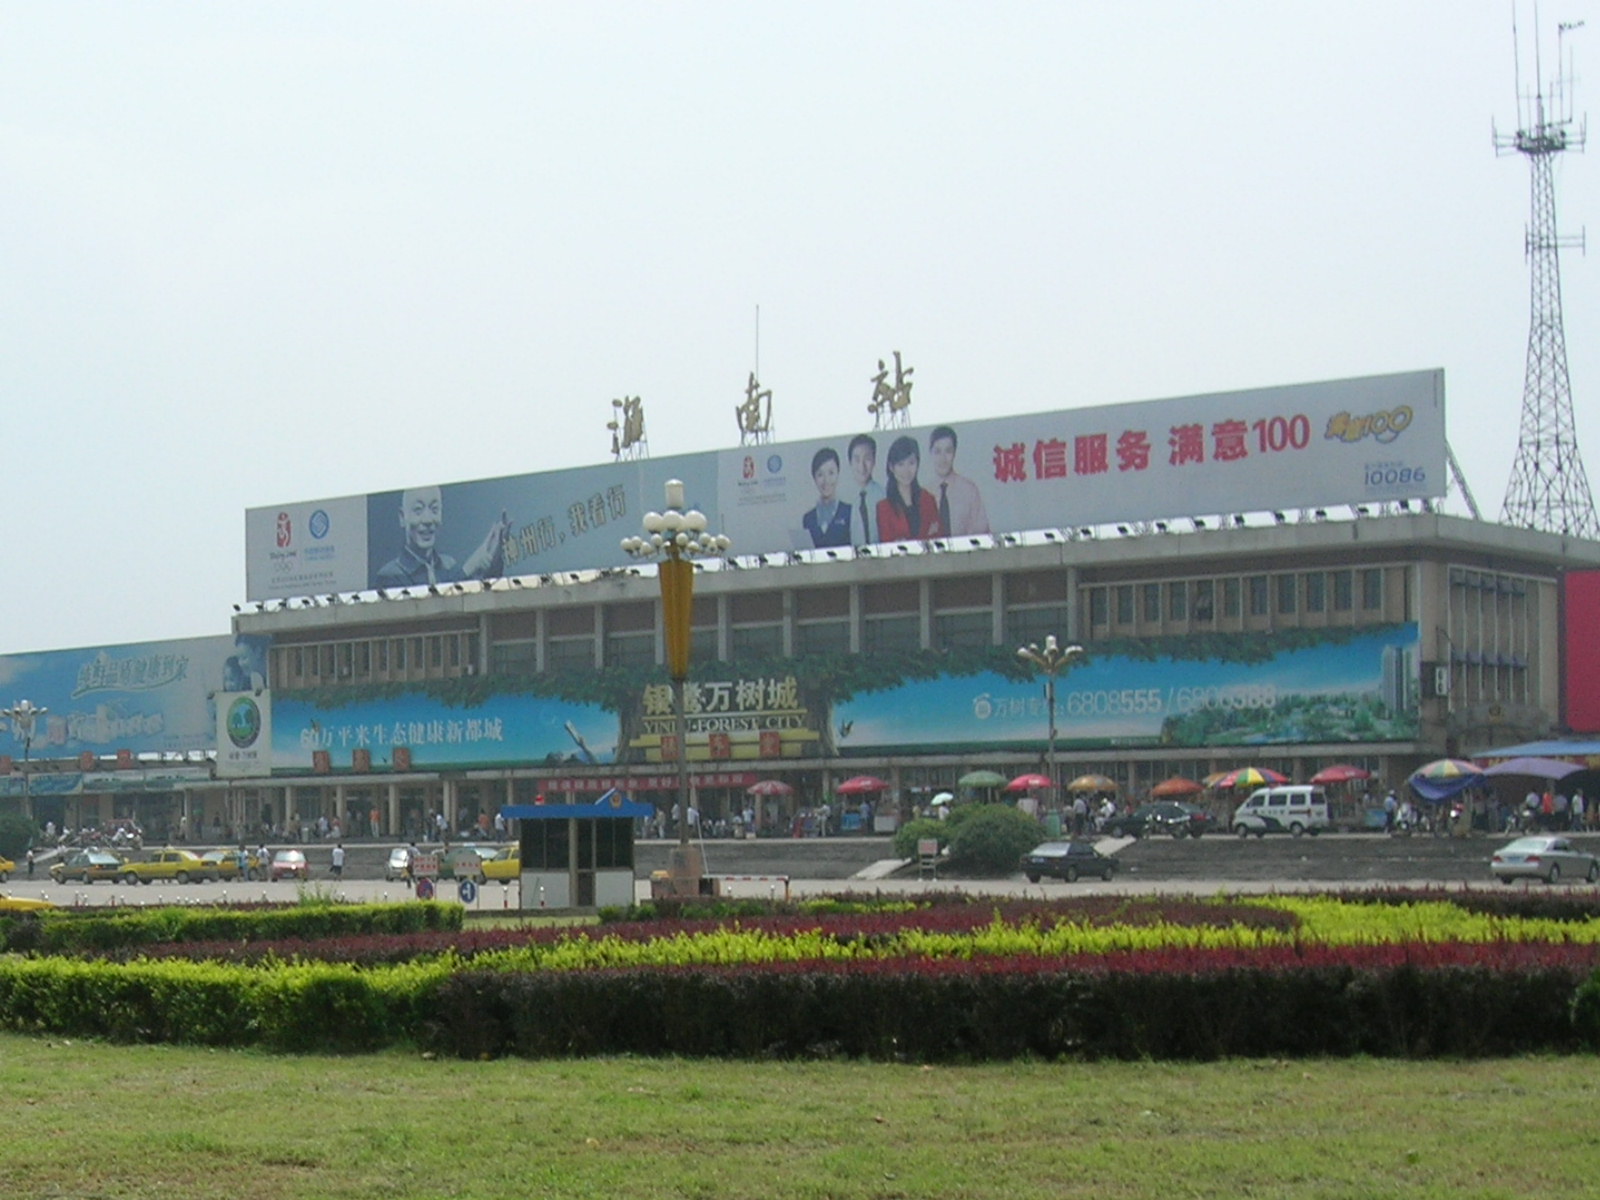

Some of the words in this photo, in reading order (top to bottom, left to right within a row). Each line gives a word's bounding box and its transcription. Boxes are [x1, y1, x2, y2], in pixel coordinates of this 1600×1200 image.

[992, 429, 1151, 483] 诚信服务
[1167, 414, 1310, 466] 满意100
[1364, 467, 1425, 486] 10086
[766, 715, 804, 729] CITY
